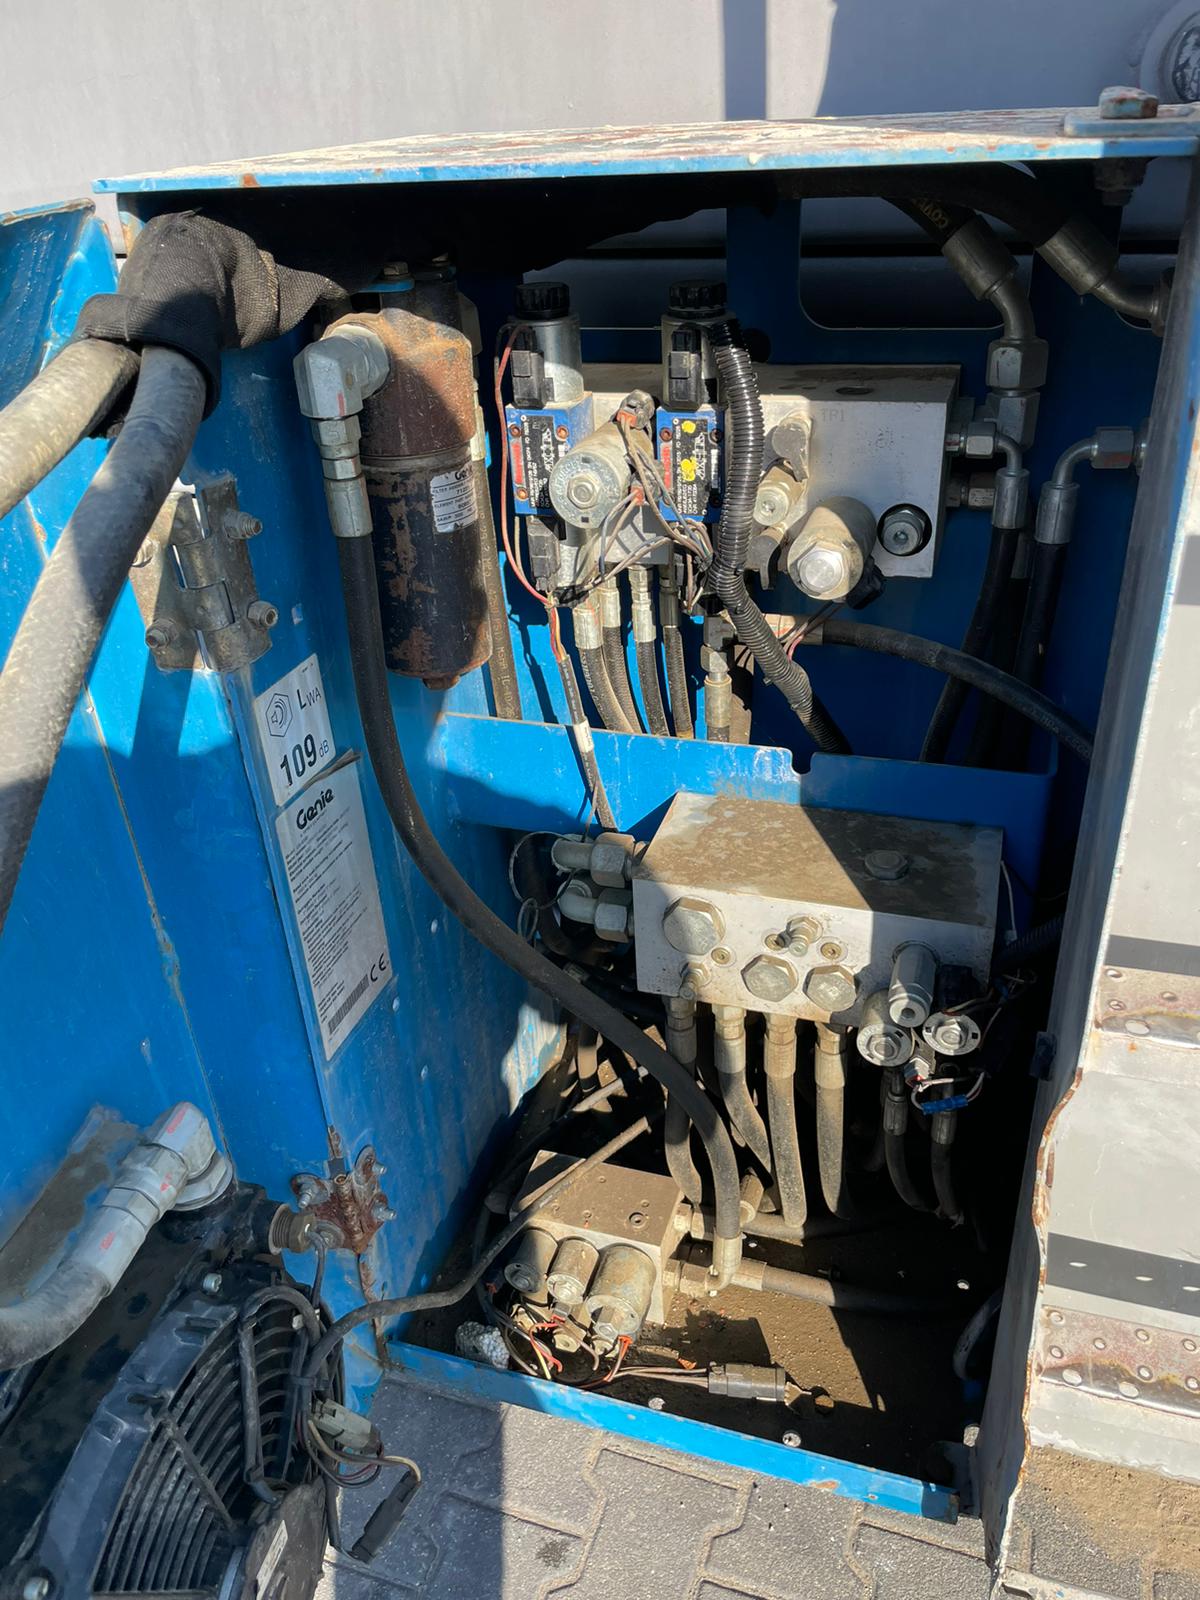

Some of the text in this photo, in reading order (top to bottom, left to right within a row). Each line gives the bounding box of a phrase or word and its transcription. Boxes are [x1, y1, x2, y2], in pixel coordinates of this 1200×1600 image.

[279, 733, 330, 787] 109 dB
[296, 787, 335, 831] Genie
